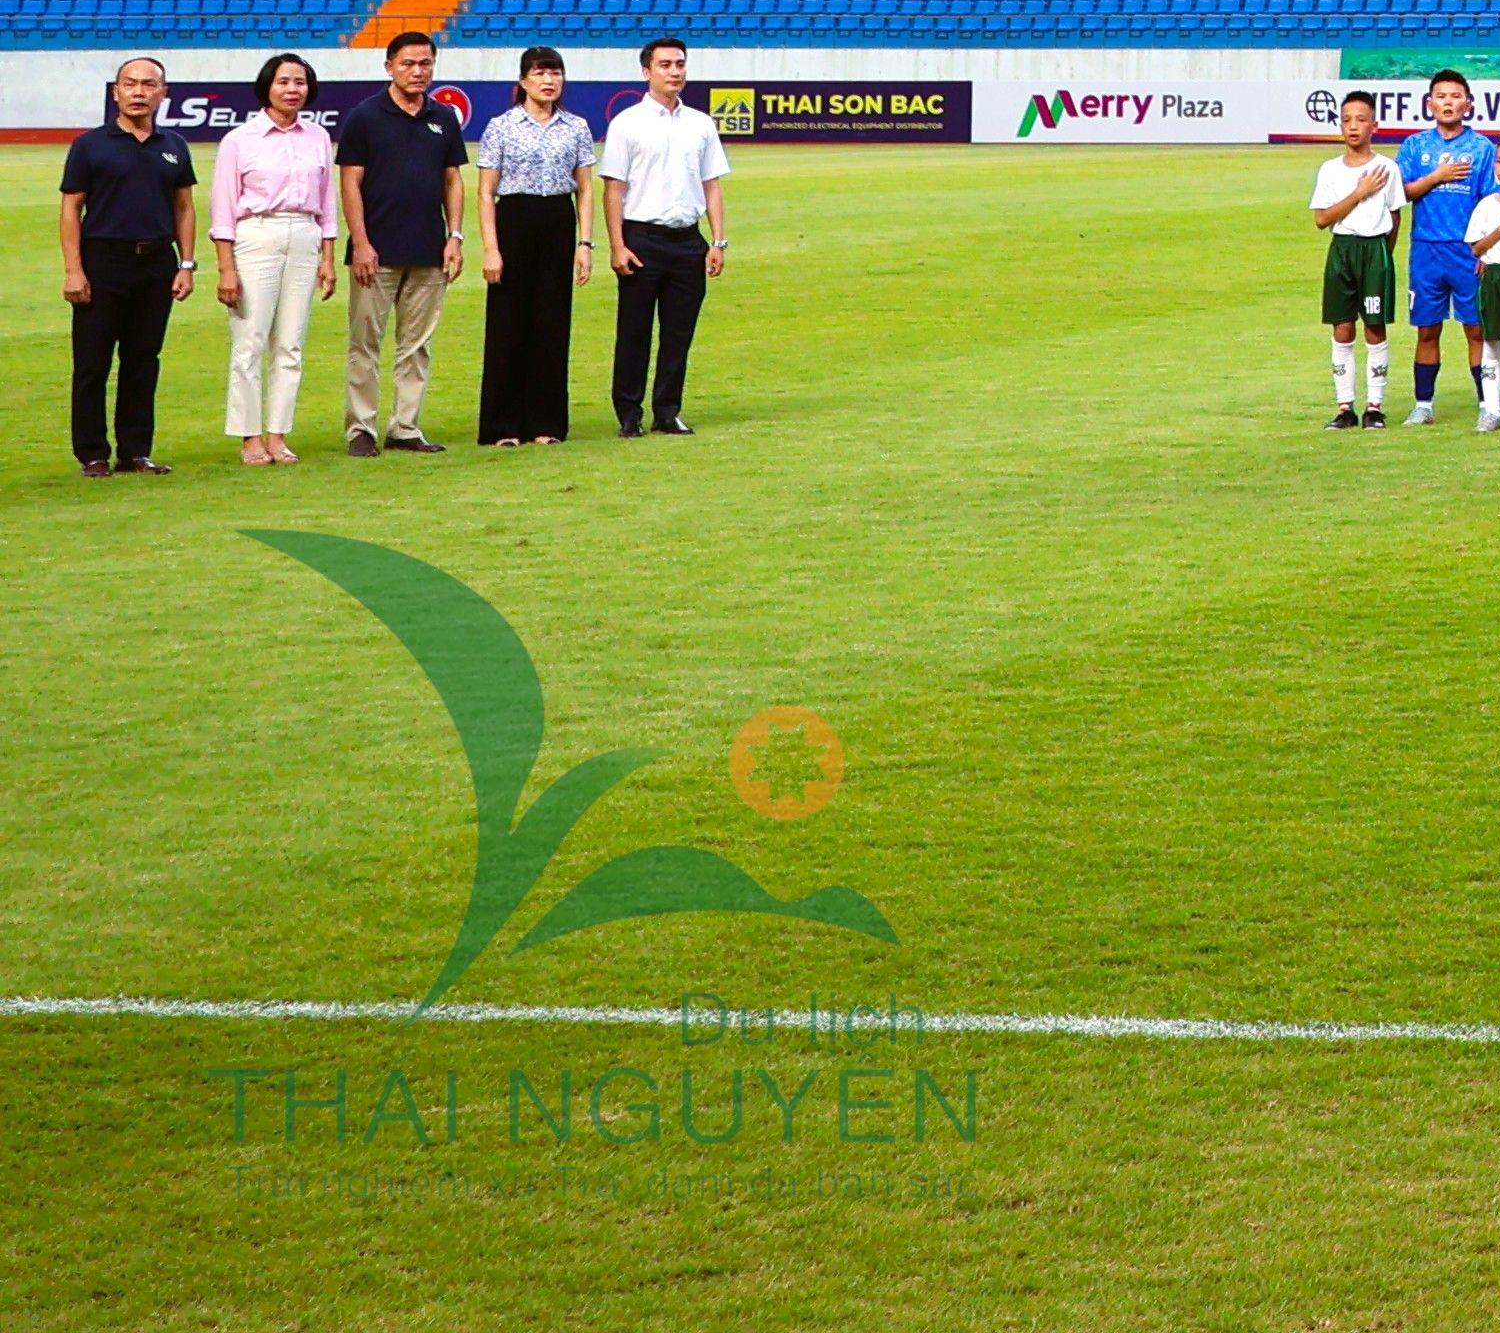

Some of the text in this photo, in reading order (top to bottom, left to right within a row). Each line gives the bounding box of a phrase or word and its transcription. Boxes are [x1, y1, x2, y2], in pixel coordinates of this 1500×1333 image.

[156, 97, 209, 128] LS
[761, 94, 944, 115] THAI SON BAC
[1017, 90, 1223, 137] Merry Plaza
[714, 116, 751, 131] TSB
